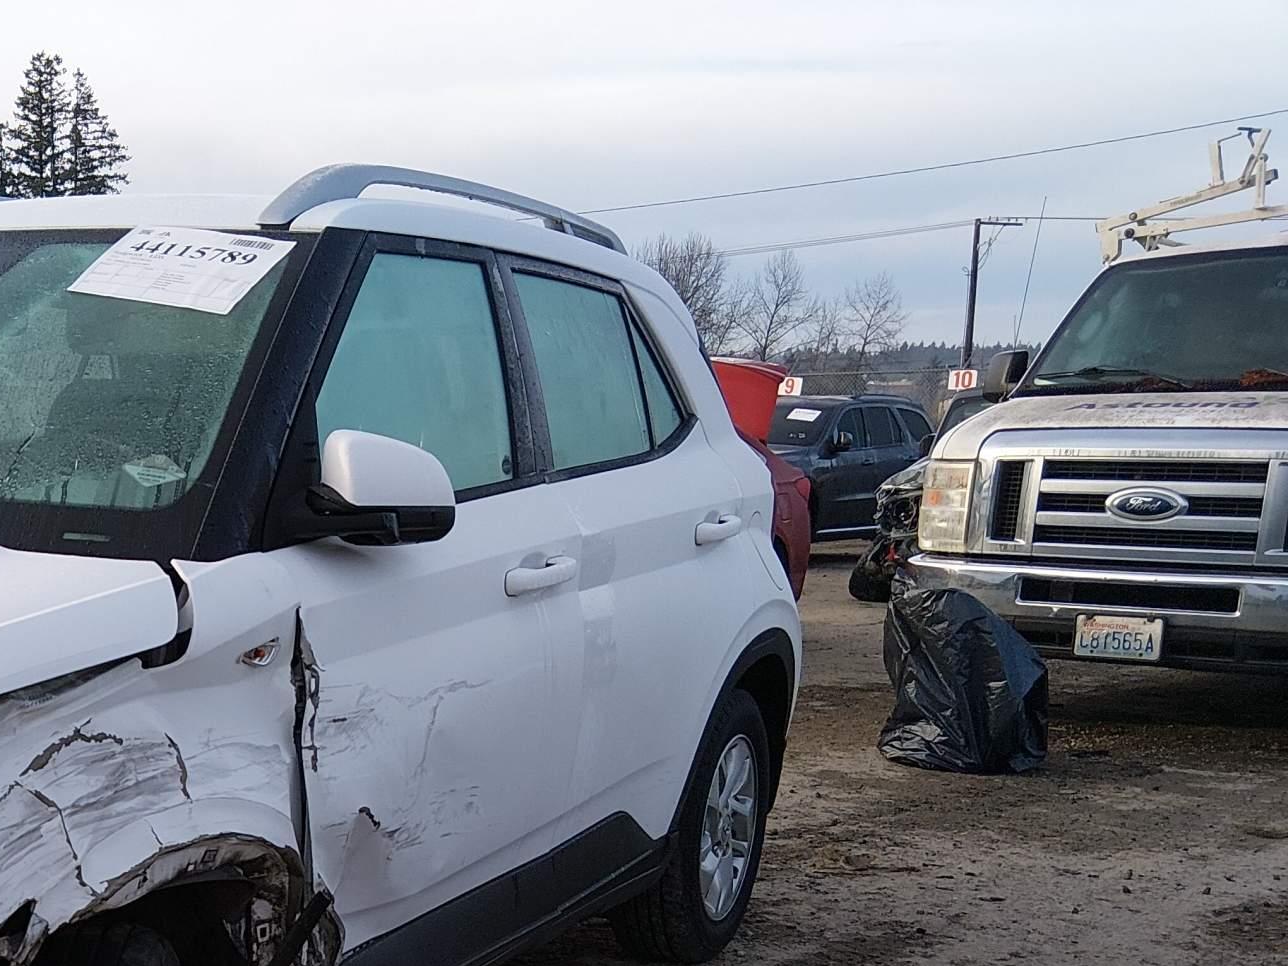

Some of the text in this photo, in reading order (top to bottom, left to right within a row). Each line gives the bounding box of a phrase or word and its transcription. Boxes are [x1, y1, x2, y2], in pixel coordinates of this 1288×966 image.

[130, 239, 259, 266] 44115789
[784, 378, 796, 395] 9
[953, 370, 973, 389] 10
[1126, 496, 1162, 511] Ford
